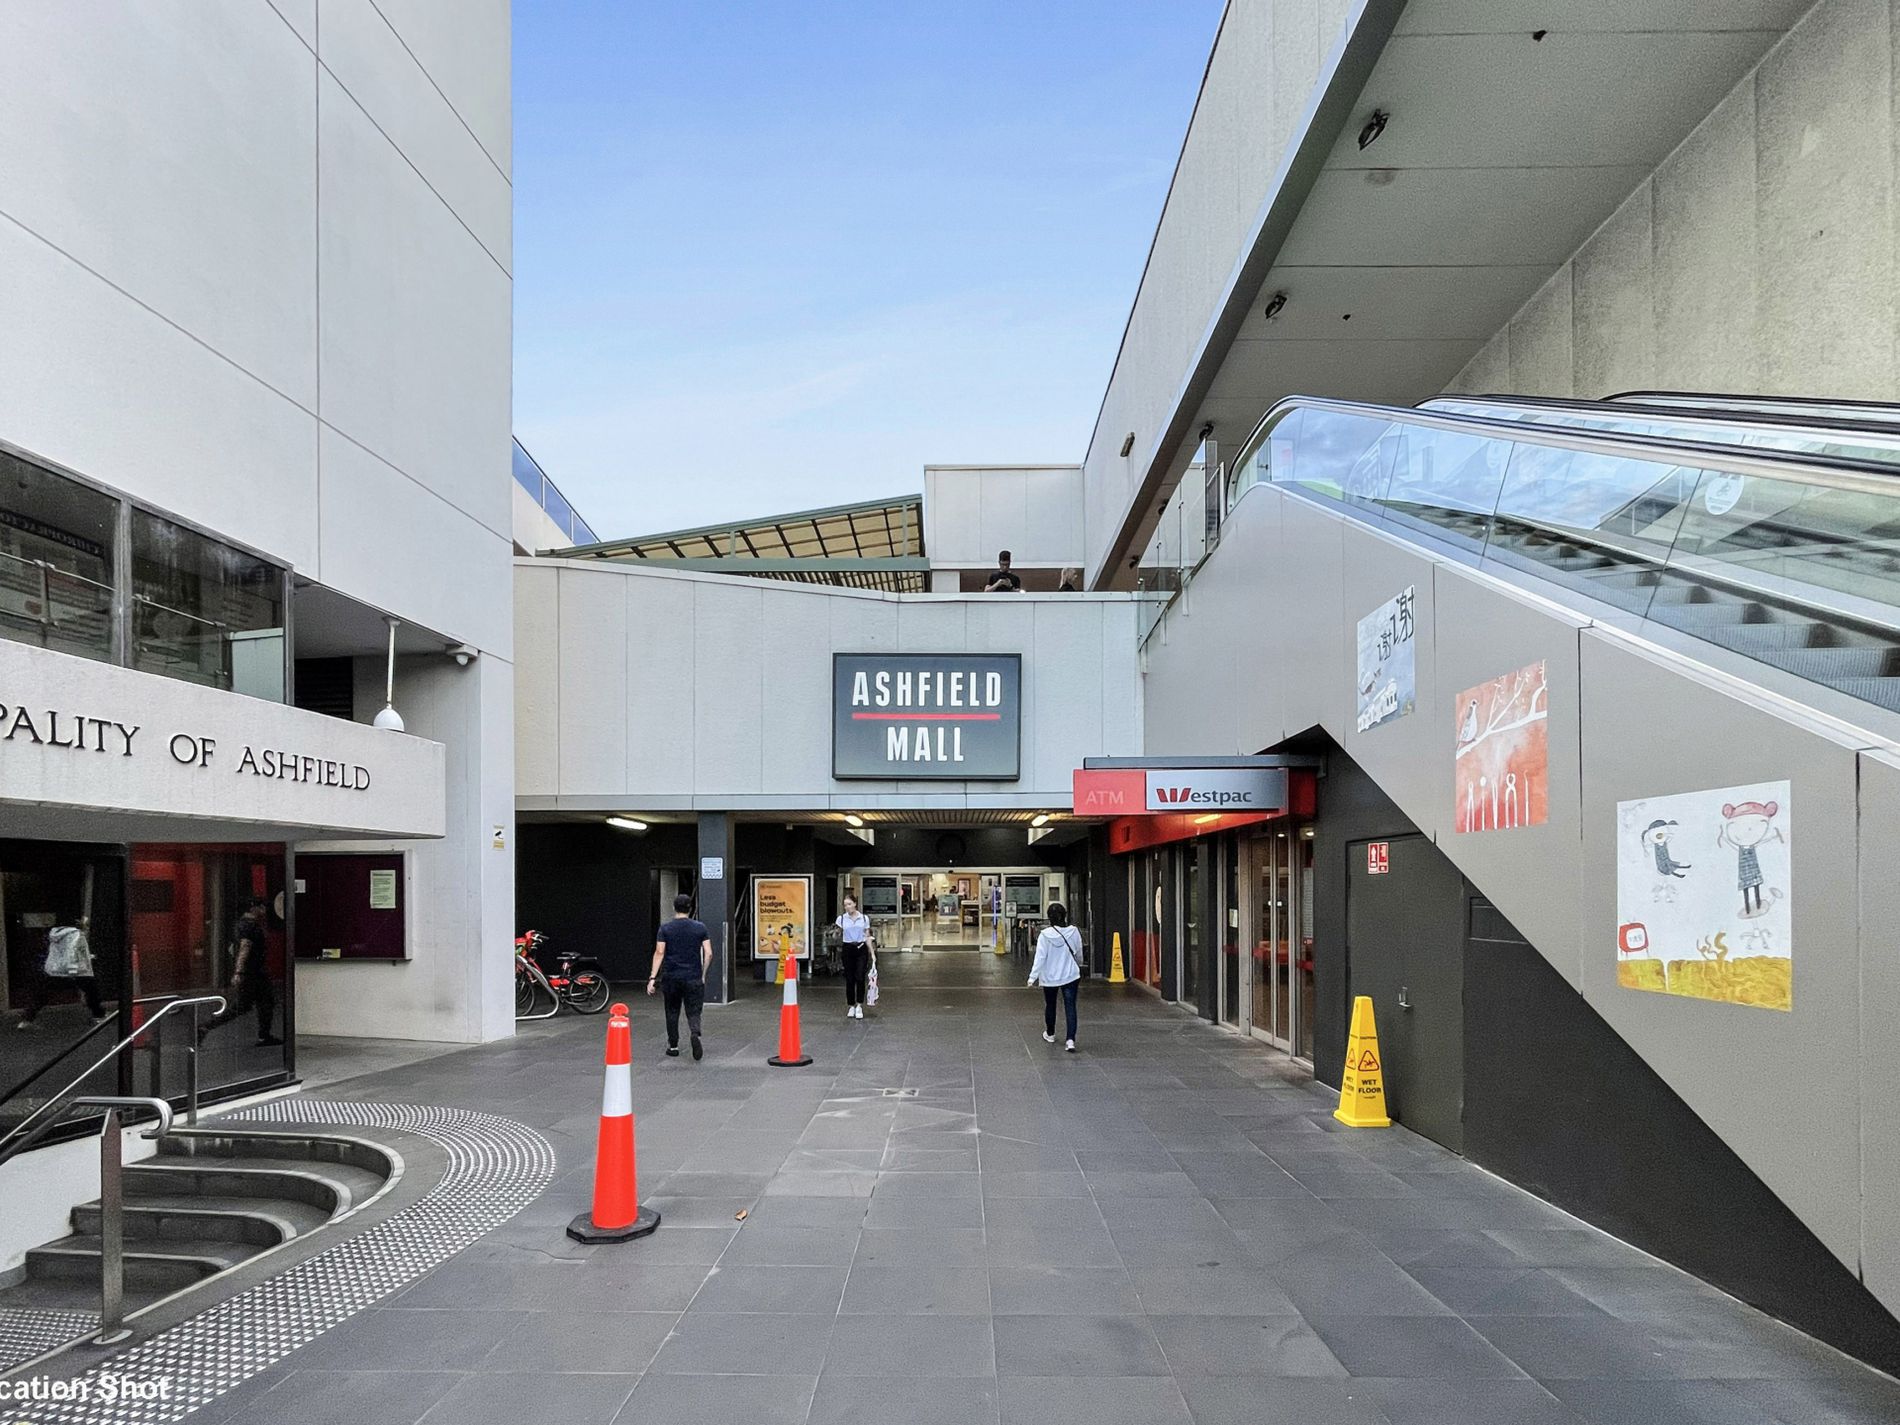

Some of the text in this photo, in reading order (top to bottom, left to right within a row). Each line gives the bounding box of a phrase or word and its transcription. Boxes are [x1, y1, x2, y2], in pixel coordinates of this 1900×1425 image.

[852, 671, 1002, 707] ASHFIELD
[169, 733, 217, 768] OF
[236, 746, 371, 791] ASHFIELD
[887, 726, 965, 762] MALL
[1085, 790, 1124, 805] ATM
[1156, 788, 1253, 805] Westpac
